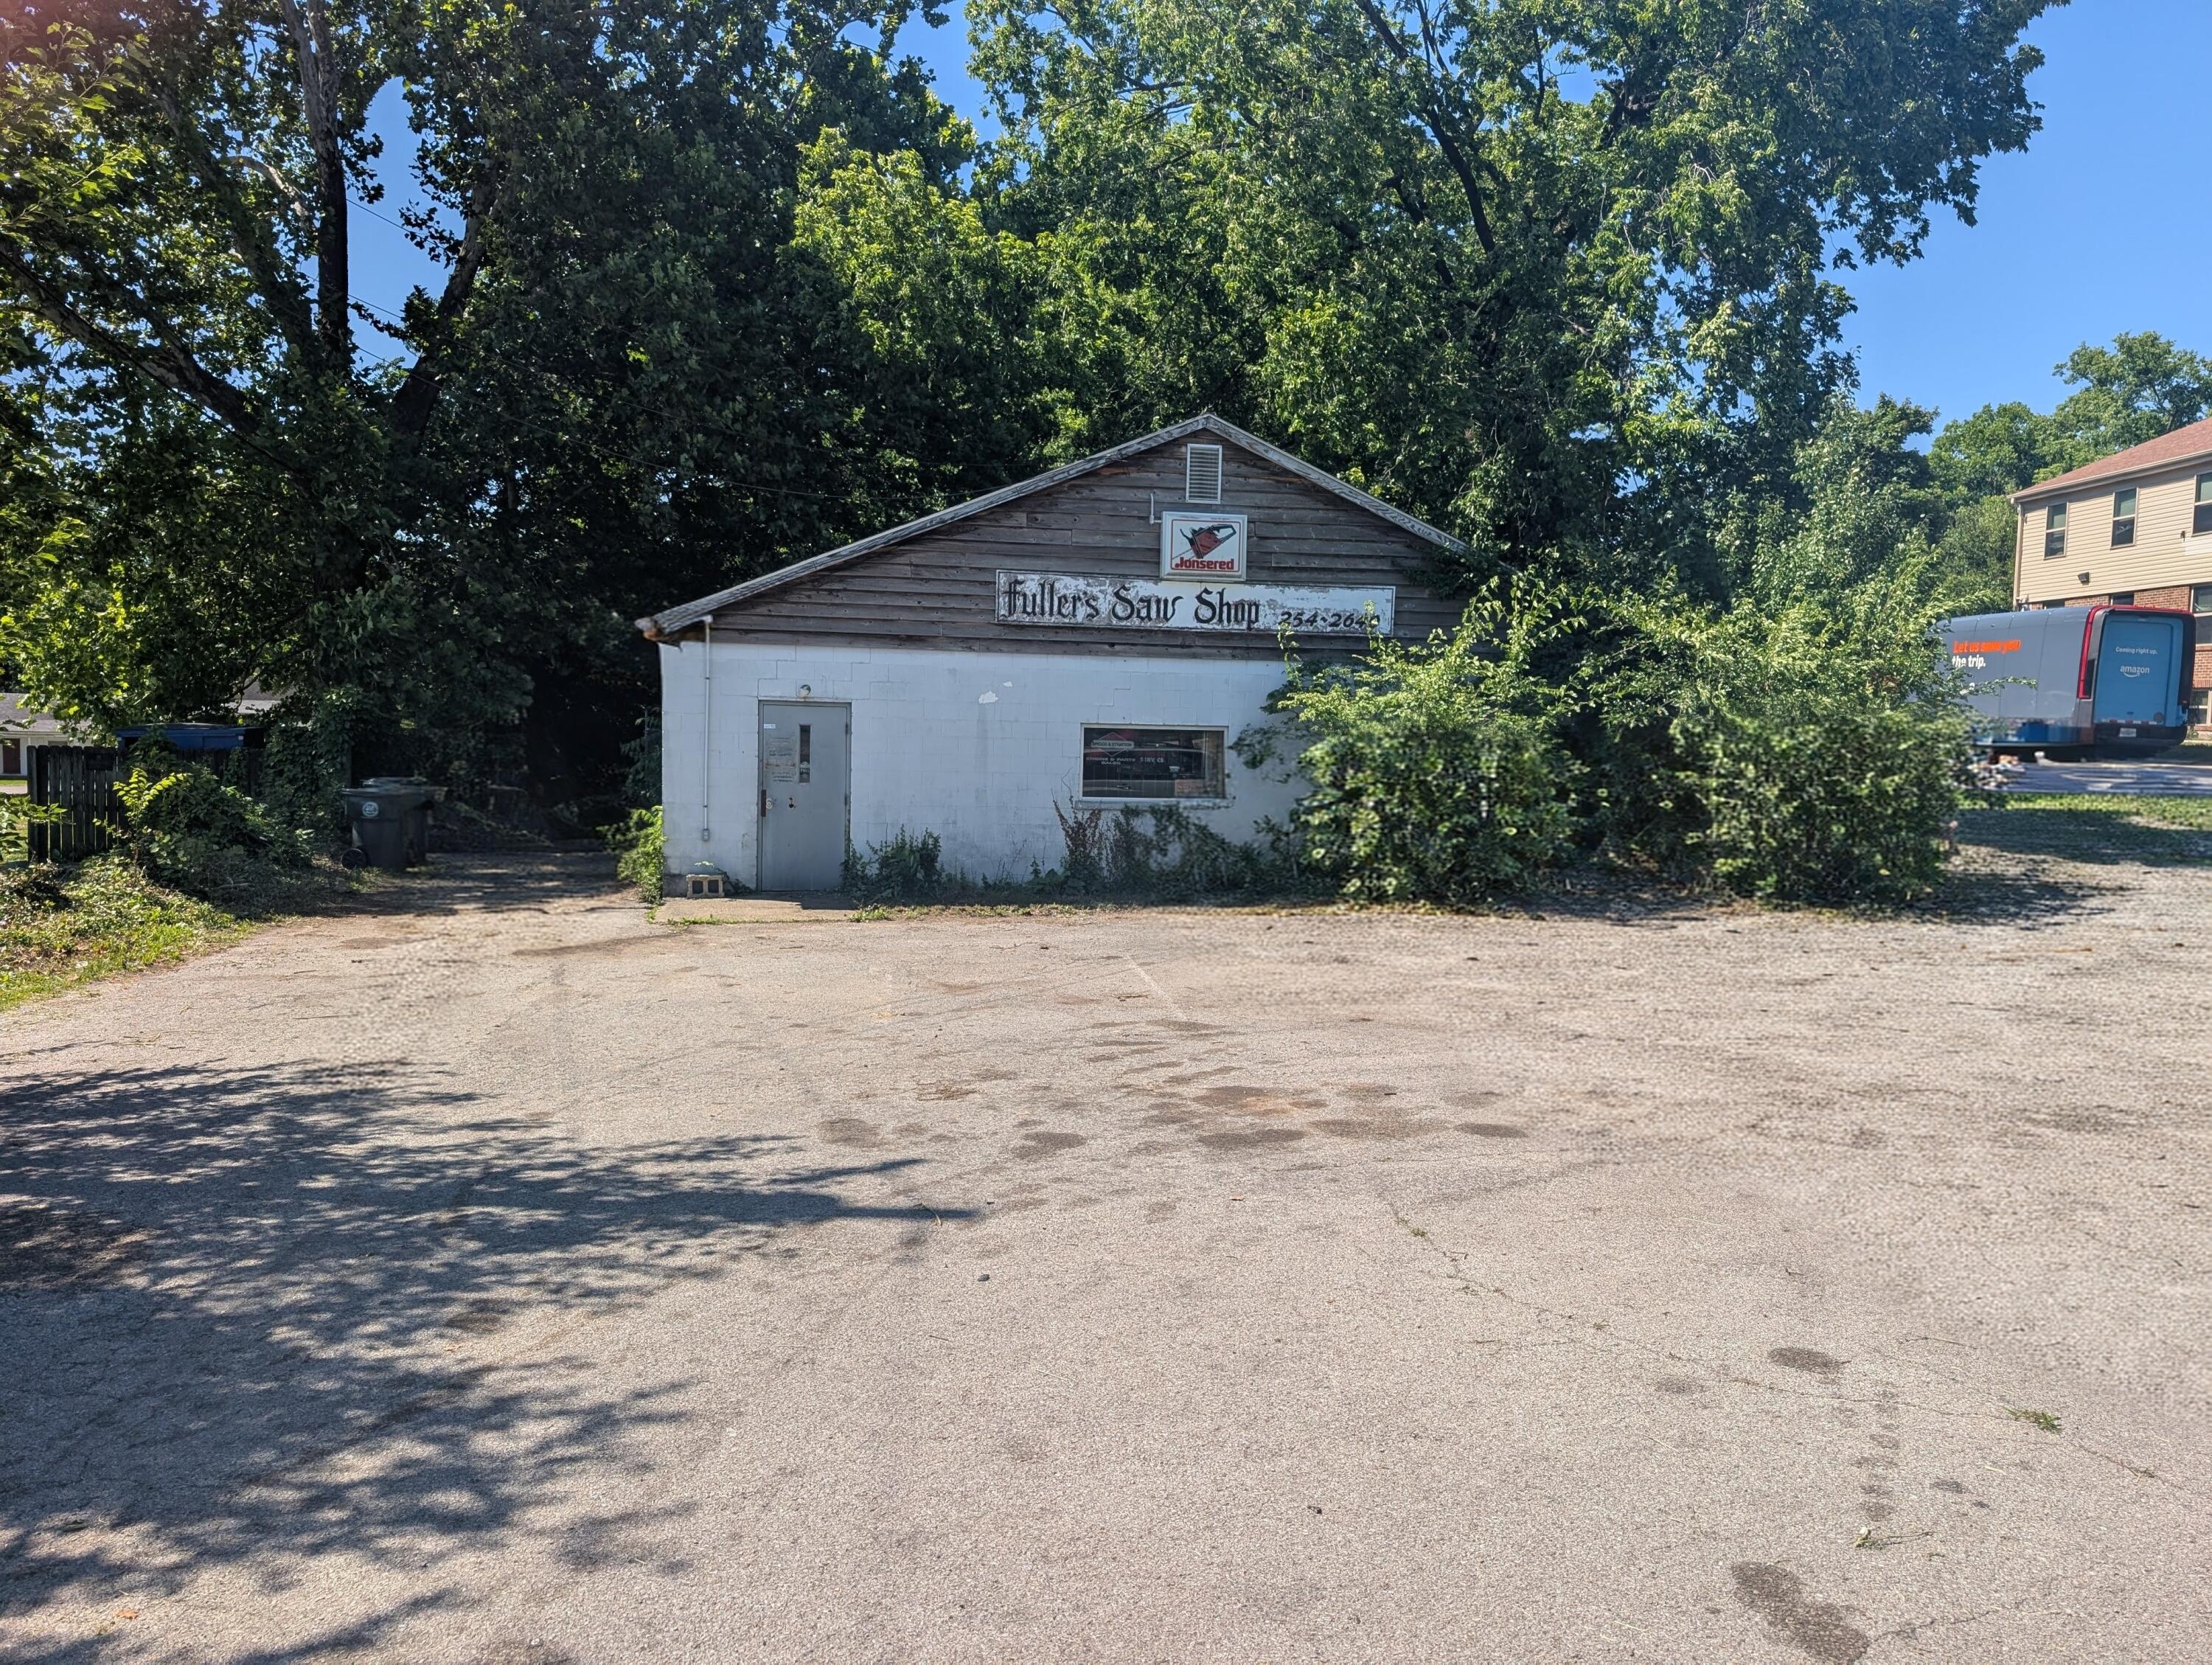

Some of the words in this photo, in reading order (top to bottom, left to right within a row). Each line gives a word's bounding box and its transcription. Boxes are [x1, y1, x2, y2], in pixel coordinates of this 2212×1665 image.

[1175, 557, 1234, 570] Jonsered
[1000, 578, 1100, 619] Fuller's
[1111, 584, 1183, 622] Saw
[1194, 586, 1259, 631] Shop
[1953, 641, 1969, 653] Let
[1952, 655, 1966, 667] the
[1968, 654, 1986, 670] trip.
[2120, 666, 2150, 674] amazon
